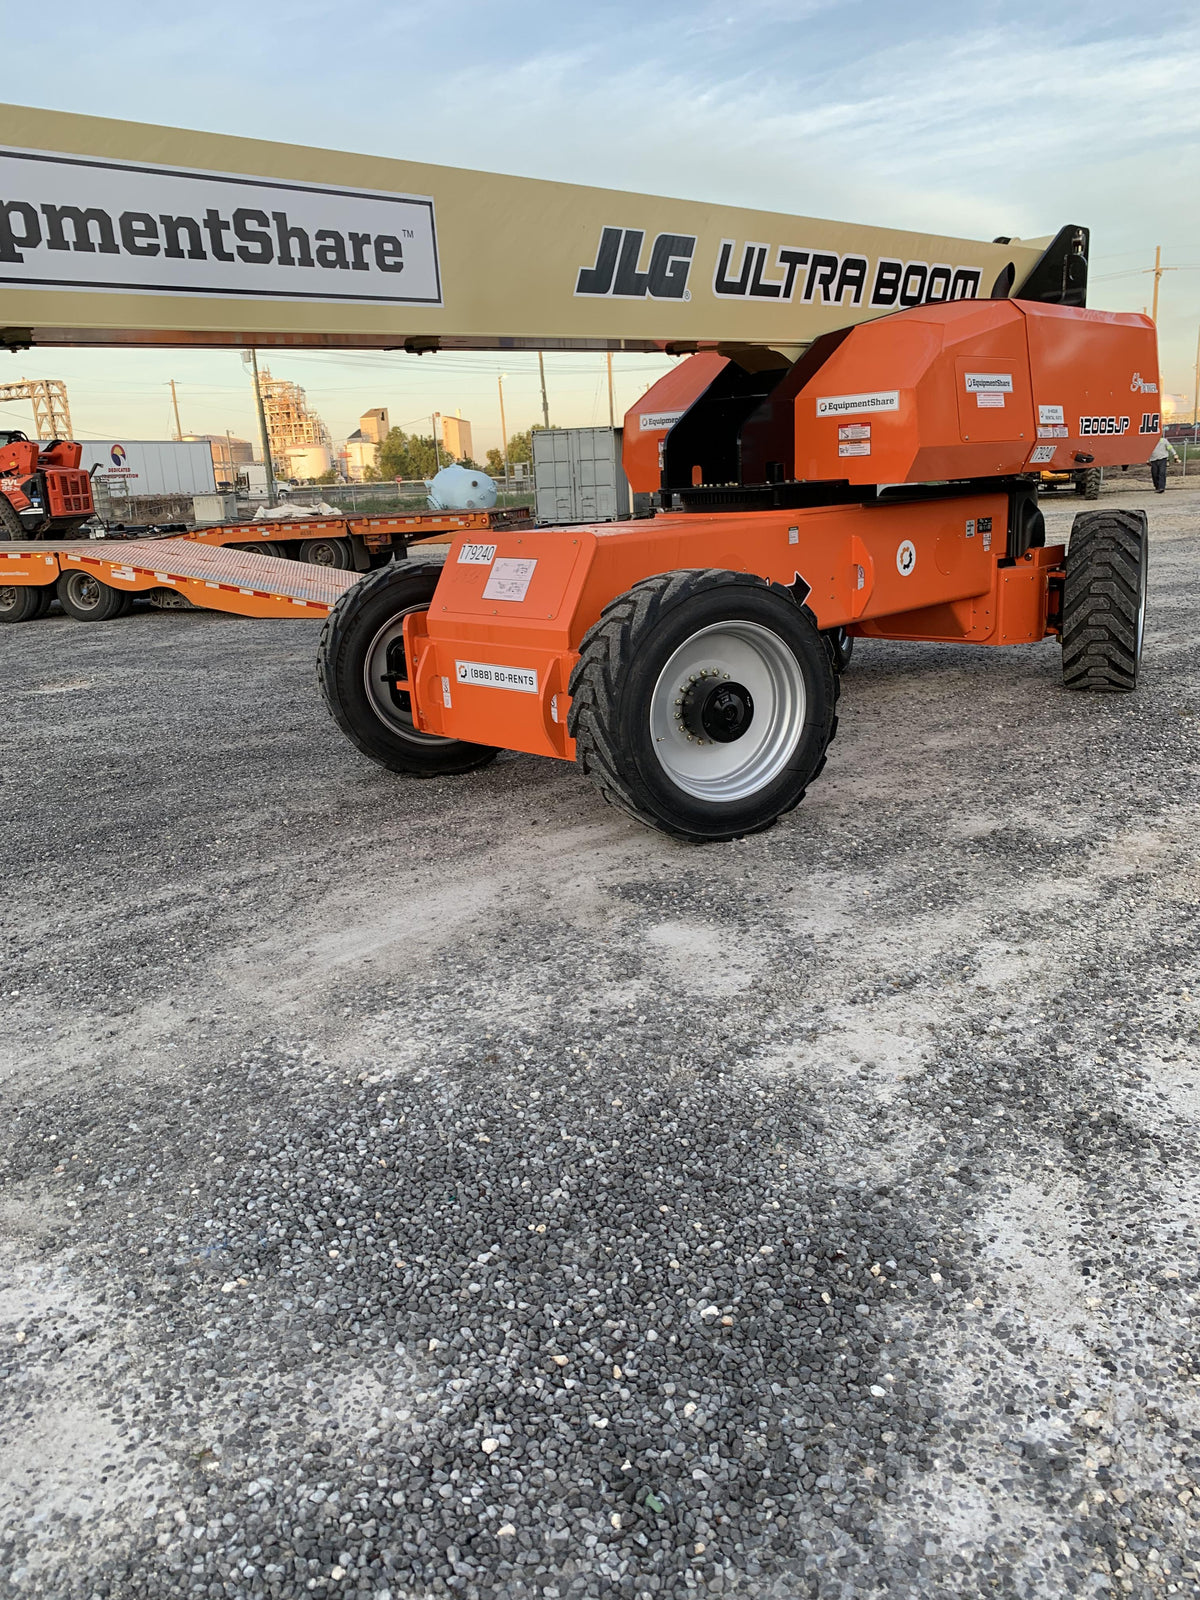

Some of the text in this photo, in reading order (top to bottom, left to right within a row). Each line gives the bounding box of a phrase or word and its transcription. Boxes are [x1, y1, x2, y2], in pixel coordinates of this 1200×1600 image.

[574, 226, 697, 299] JLG
[715, 243, 982, 306] ULTRA BOOM
[828, 398, 895, 411] EquipmentShare
[1080, 417, 1130, 435] 1200SJP
[1139, 413, 1160, 434] JLG
[460, 545, 495, 560] 179240
[470, 668, 534, 686] (888) 80-RENTS
